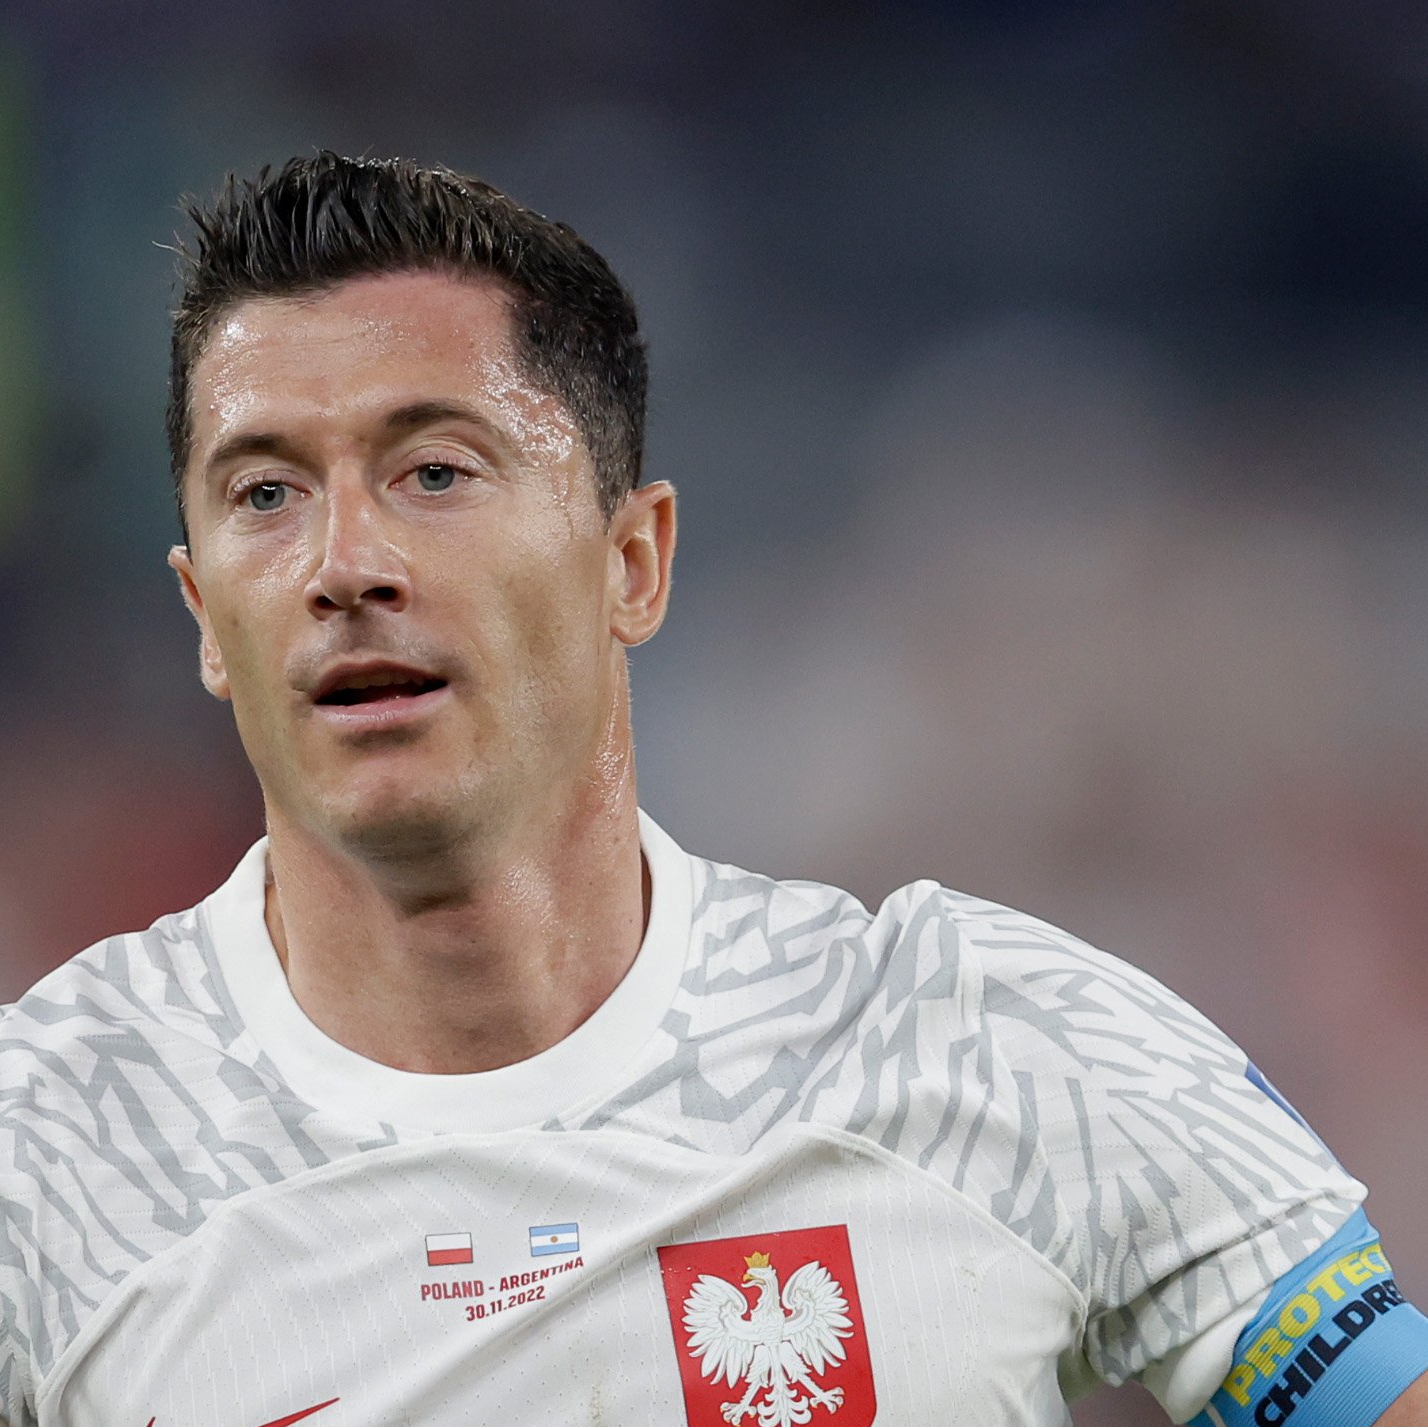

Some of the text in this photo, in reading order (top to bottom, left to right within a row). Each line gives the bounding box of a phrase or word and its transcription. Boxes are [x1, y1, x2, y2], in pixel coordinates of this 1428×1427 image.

[420, 1280, 484, 1301] POLAND
[499, 1256, 584, 1292] ARGENTINA
[465, 1285, 546, 1322] 30.11.2022
[1222, 1243, 1393, 1407] PROTEC
